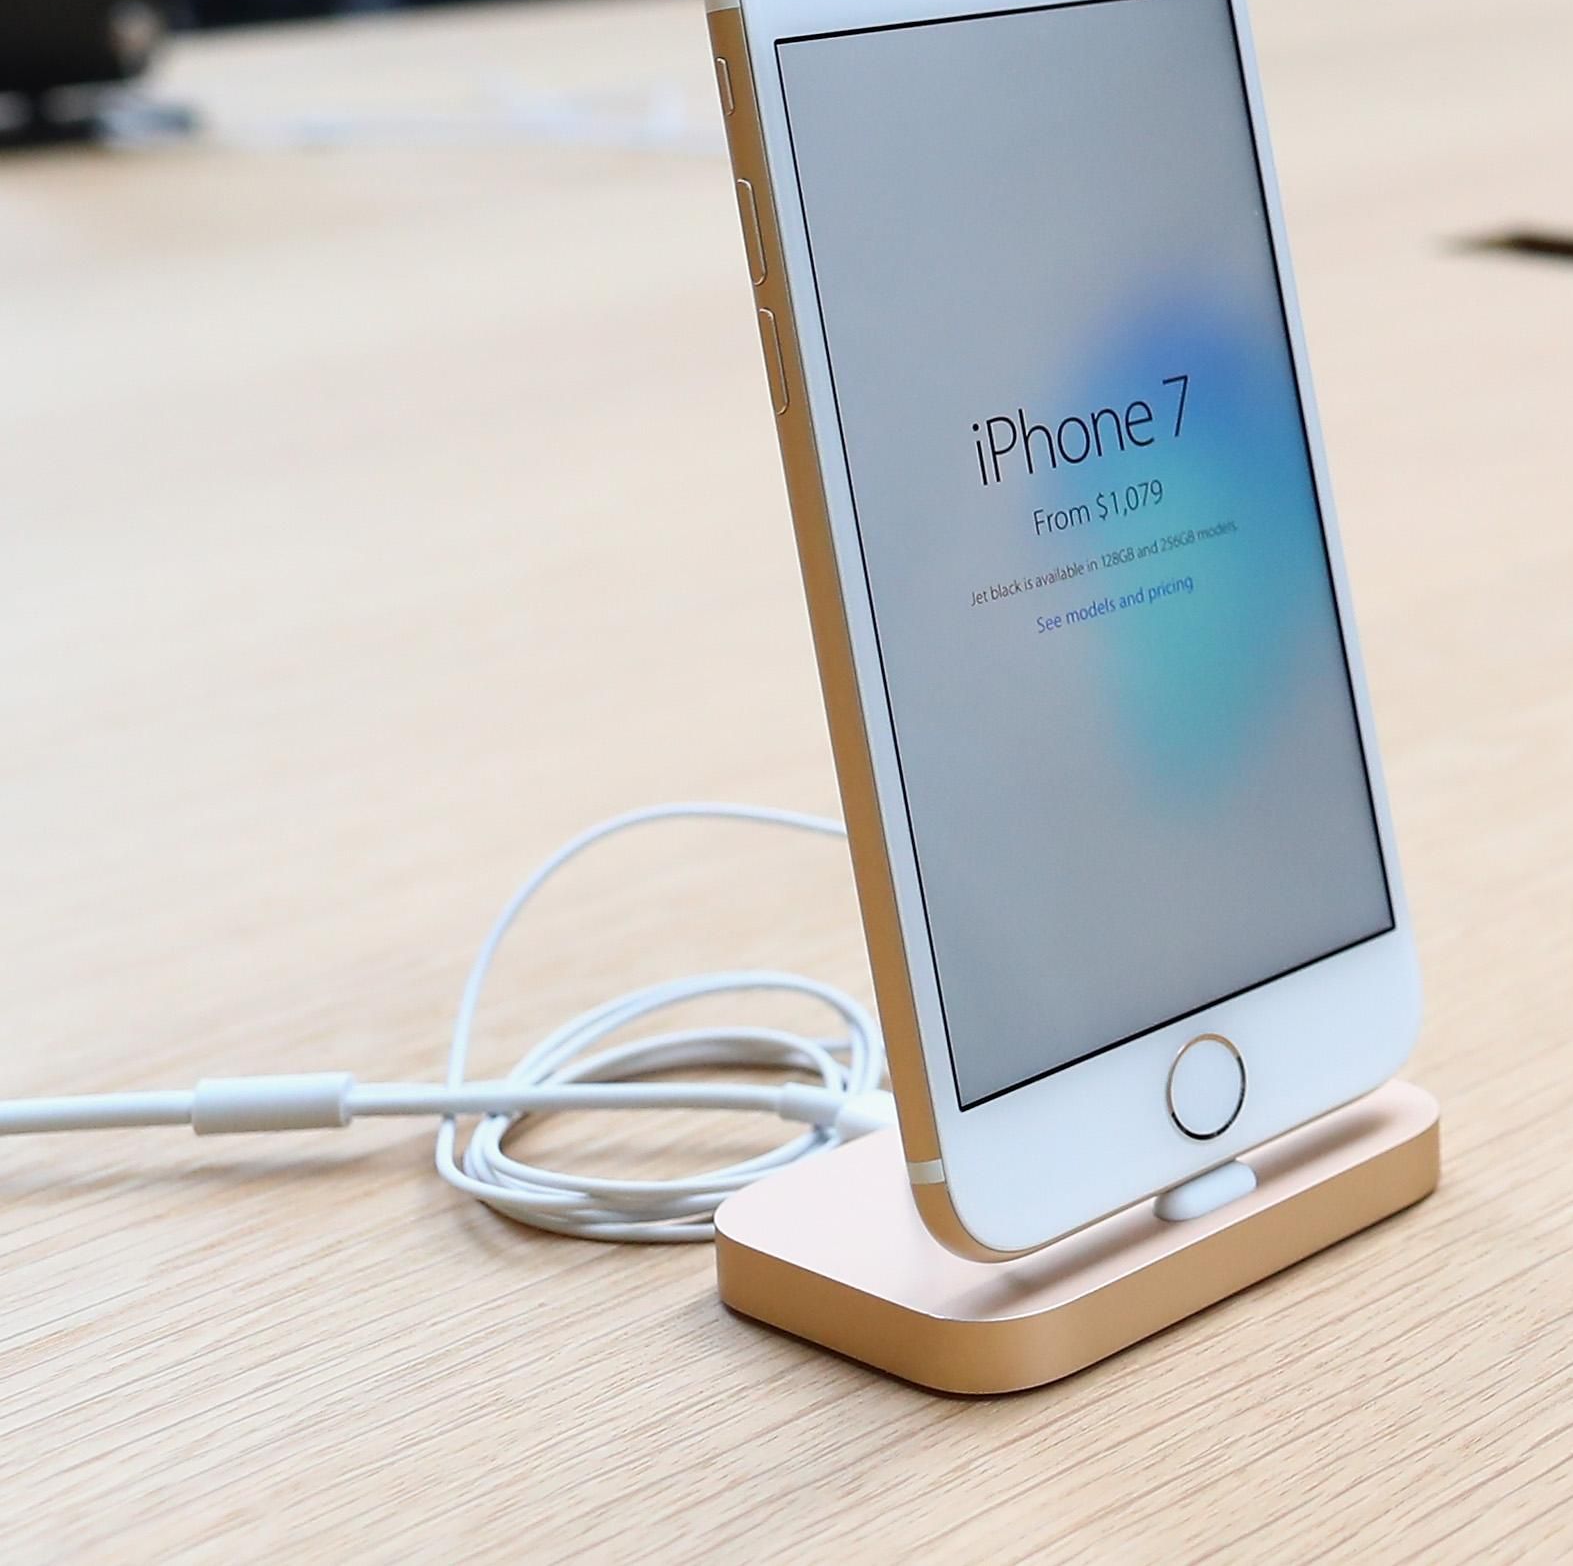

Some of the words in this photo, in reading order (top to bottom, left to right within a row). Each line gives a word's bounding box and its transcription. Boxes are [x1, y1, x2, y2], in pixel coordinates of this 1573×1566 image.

[971, 400, 1154, 485] iPhone
[1162, 374, 1188, 437] 7
[1033, 504, 1091, 535] From
[1096, 479, 1164, 521] $1,079
[970, 591, 988, 607] Jet
[990, 580, 1021, 600] black
[1024, 577, 1033, 590] is
[1035, 562, 1084, 588] available
[1086, 559, 1098, 573] in
[1101, 547, 1135, 568] 128GB
[1137, 540, 1159, 559] and
[1036, 616, 1062, 634] See
[1066, 597, 1116, 625] models
[1119, 586, 1144, 609] and
[1148, 575, 1194, 604] pricing
